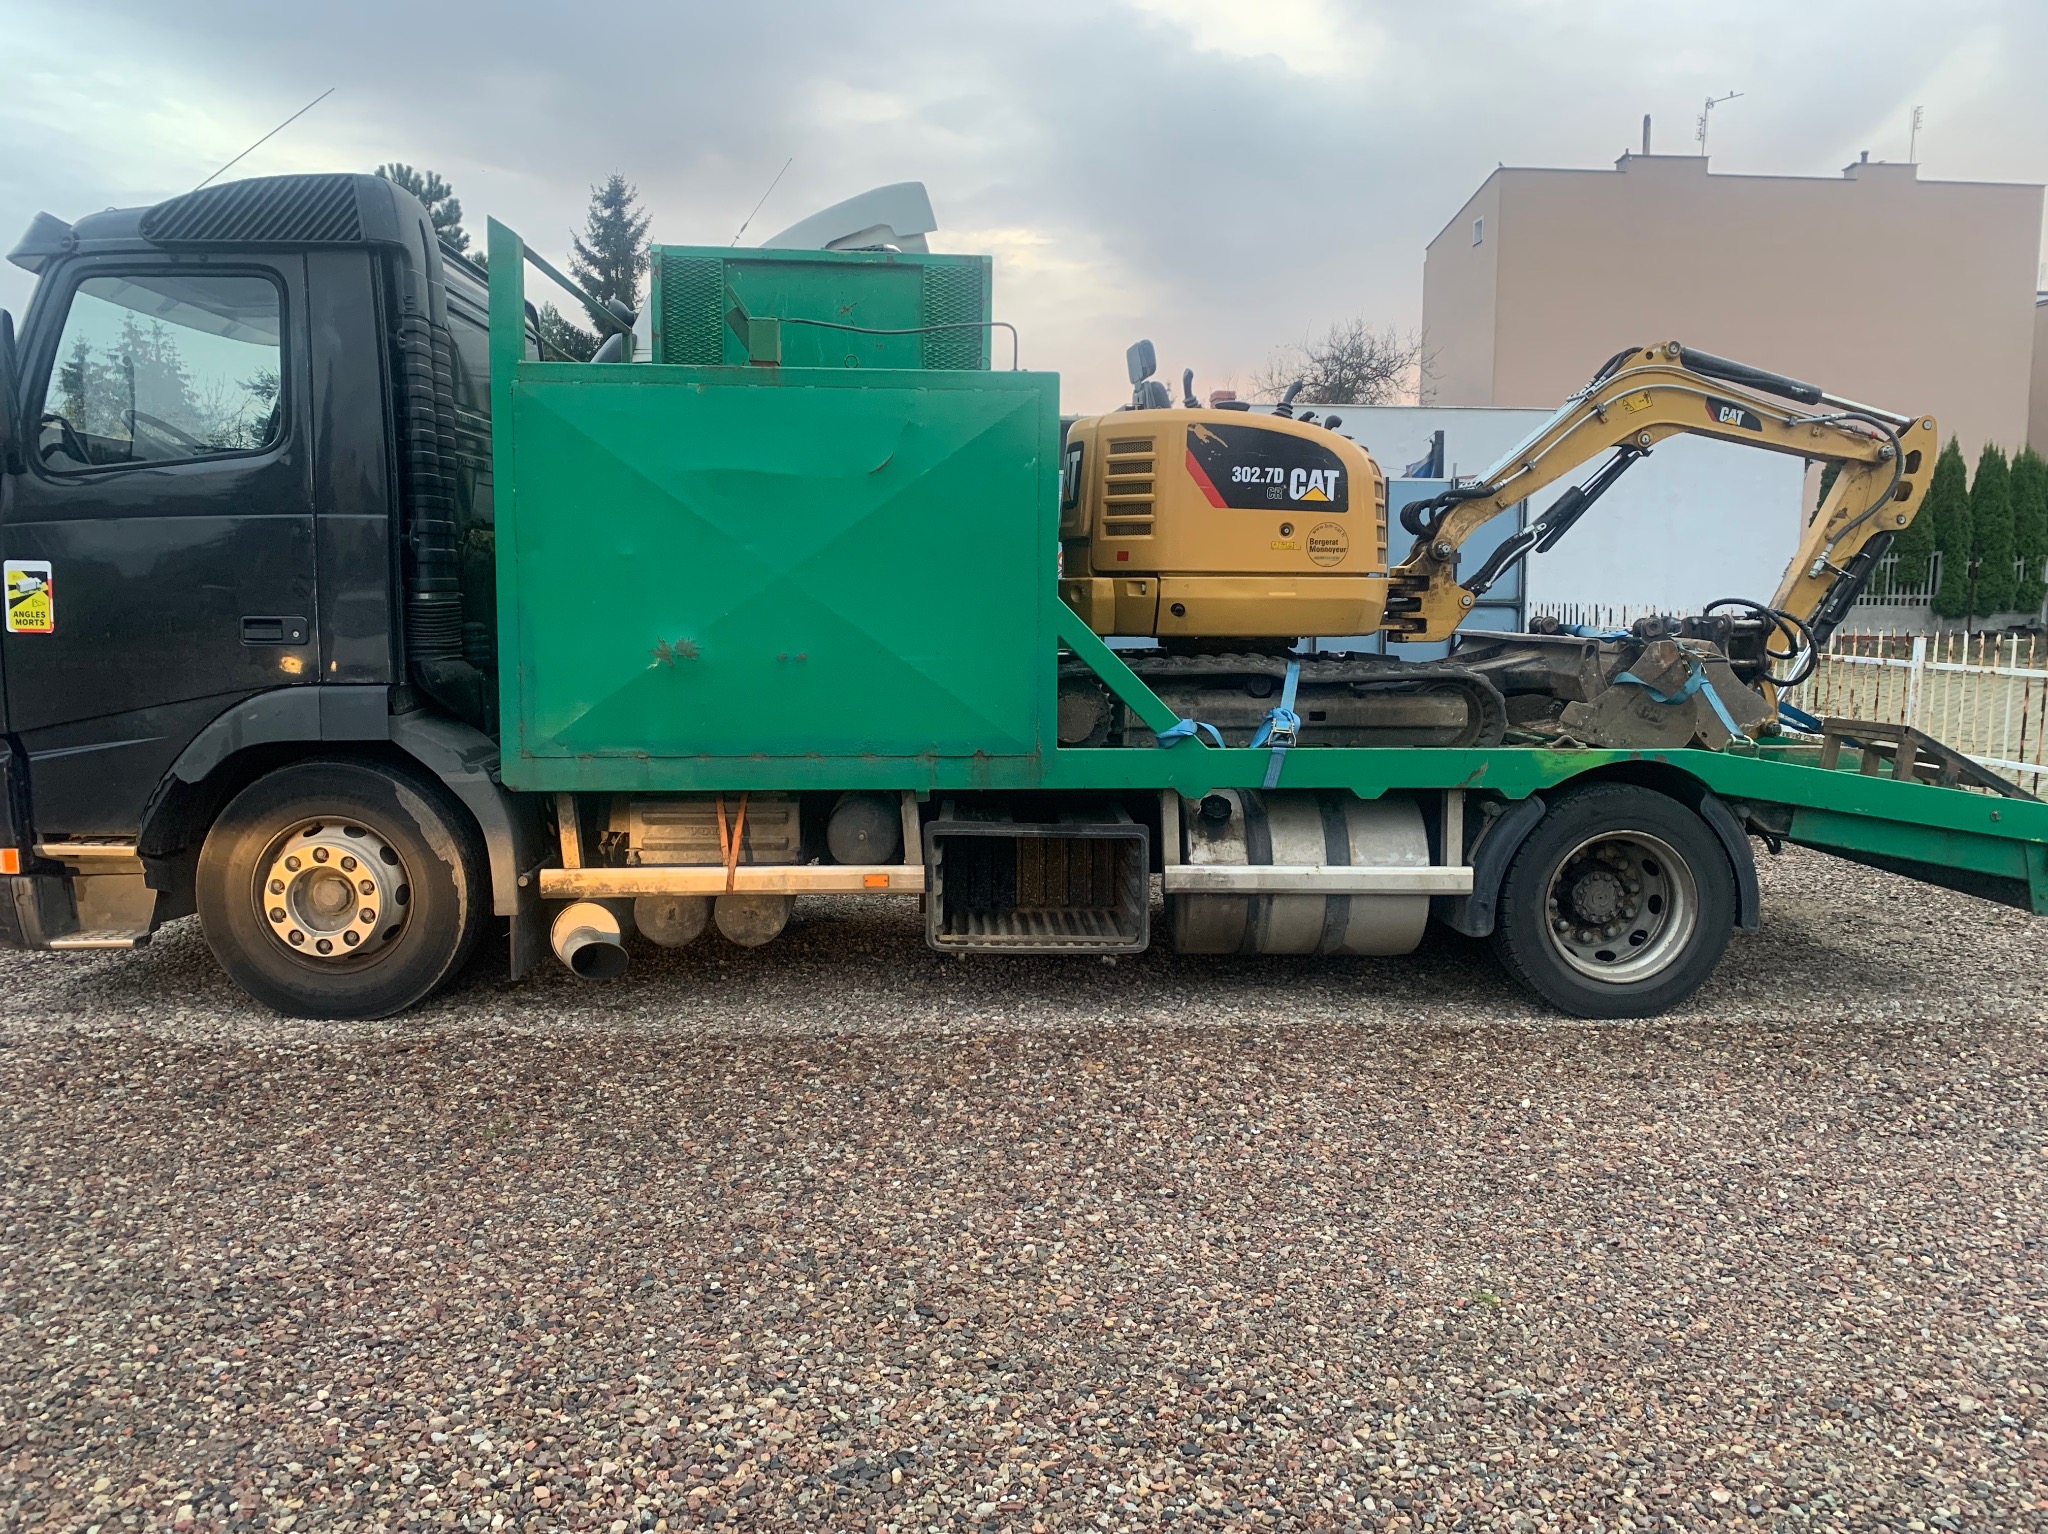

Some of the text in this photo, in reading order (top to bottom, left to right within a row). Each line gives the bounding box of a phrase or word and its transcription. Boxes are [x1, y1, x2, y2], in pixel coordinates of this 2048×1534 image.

[1719, 406, 1745, 426] CAT
[1231, 466, 1284, 484] 302.7D
[1289, 467, 1340, 502] CAT
[1266, 486, 1283, 500] CR
[1309, 537, 1339, 547] Bergerat
[1309, 545, 1347, 555] Monnoyeur
[13, 610, 46, 619] ANGLES
[15, 618, 45, 627] MORTS
